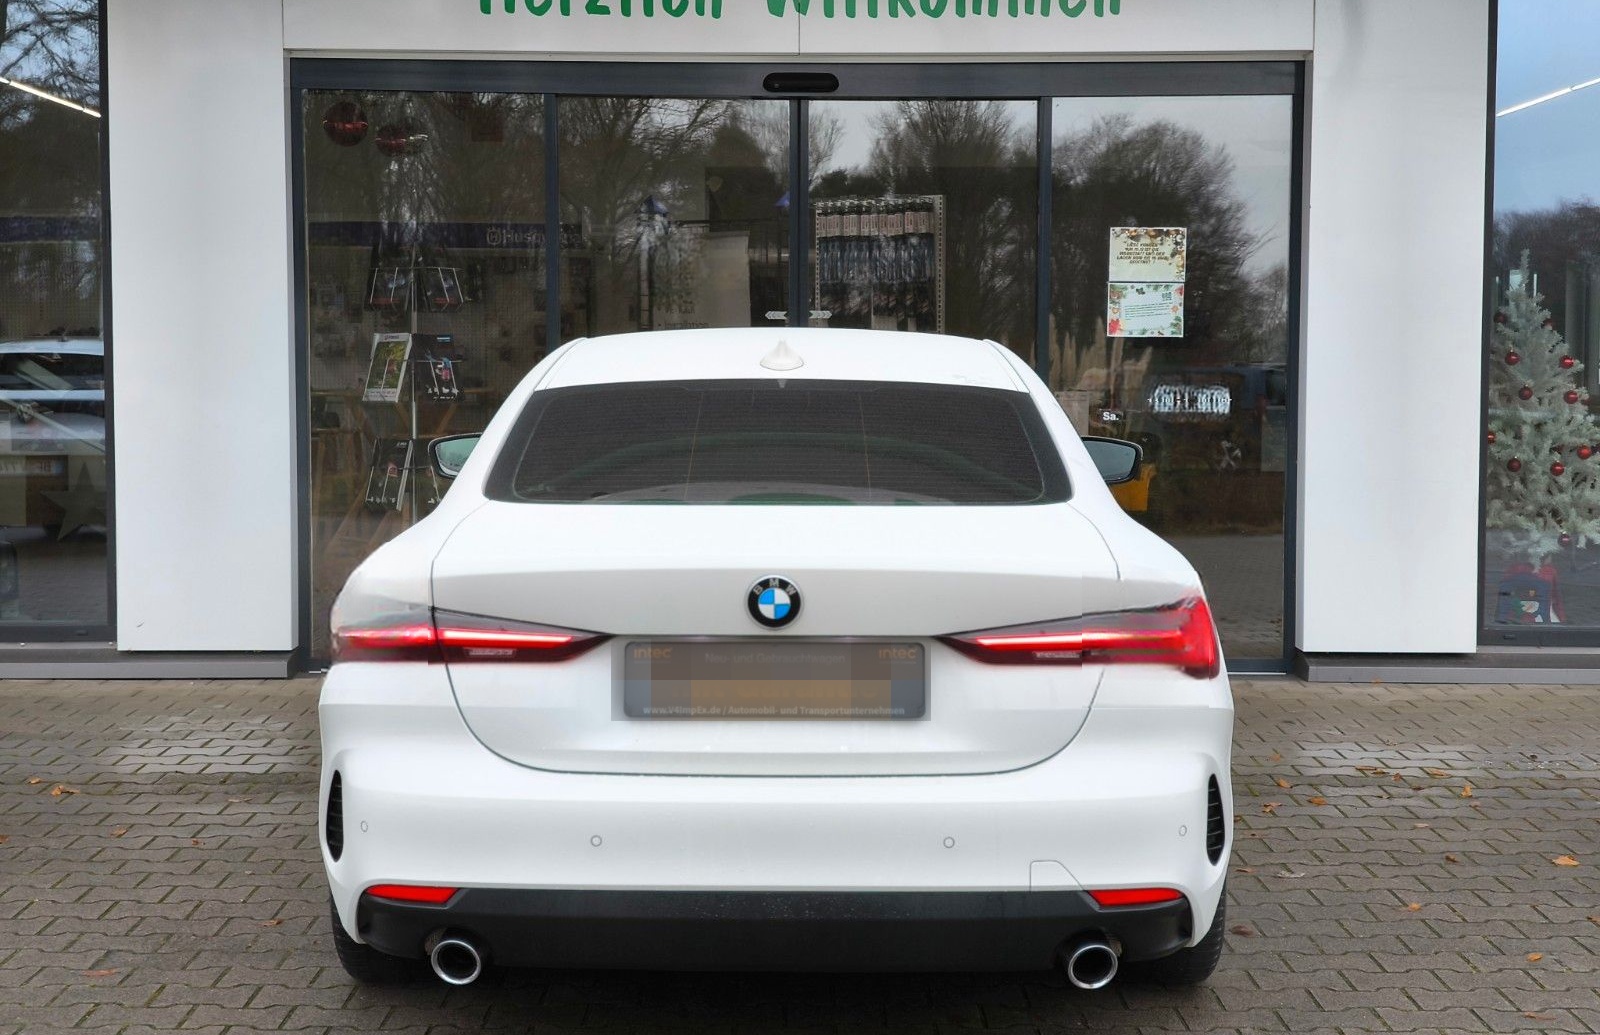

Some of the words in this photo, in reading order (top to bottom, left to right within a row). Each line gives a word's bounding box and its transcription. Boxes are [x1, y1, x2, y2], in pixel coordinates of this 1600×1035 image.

[1102, 411, 1119, 421] Sa.
[753, 578, 797, 596] BMW
[633, 647, 672, 659] intec
[878, 647, 917, 659] intec
[705, 653, 730, 664] Neu-
[733, 653, 753, 664] und
[756, 652, 845, 667] Gebrauchtwagen
[728, 705, 778, 715] Automobil-
[780, 706, 798, 715] und
[800, 705, 905, 716] Transportunternehmen
